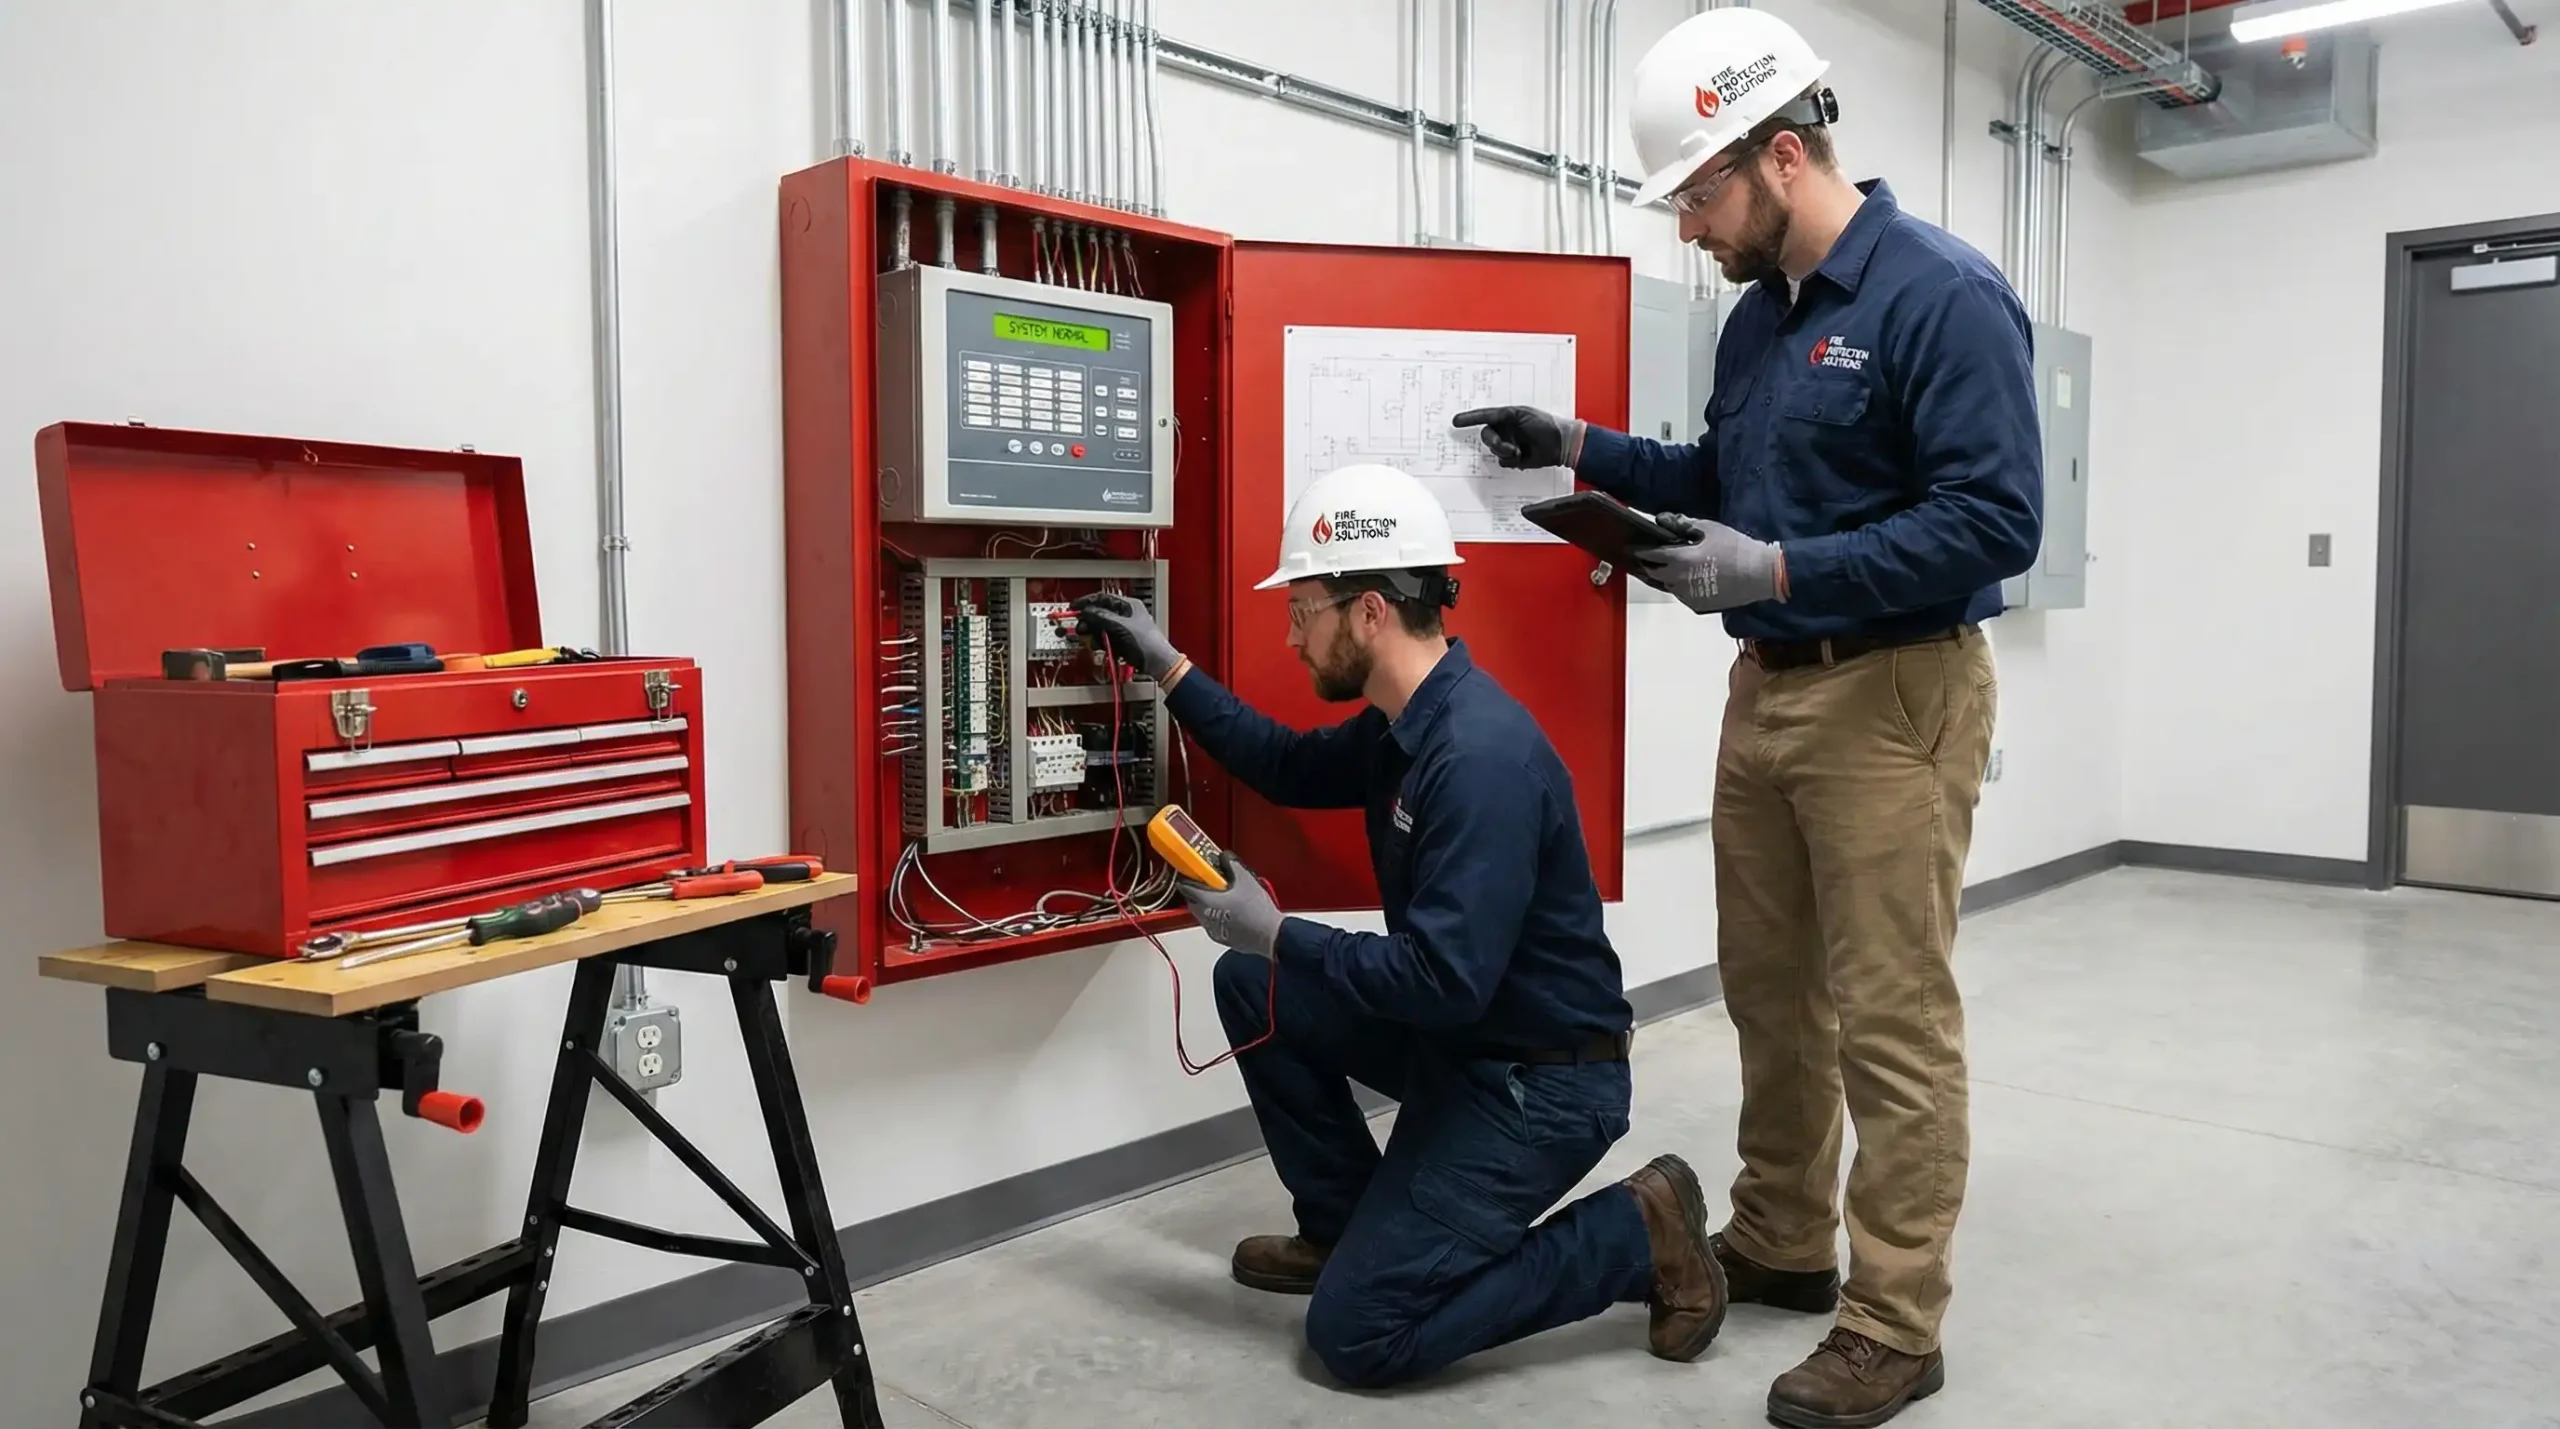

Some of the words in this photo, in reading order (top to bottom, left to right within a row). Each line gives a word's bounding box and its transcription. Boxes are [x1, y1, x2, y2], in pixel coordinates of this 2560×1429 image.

[1723, 65, 1777, 106] SOLUTIONS
[1008, 320, 1048, 338] SYSTEM
[1335, 509, 1356, 520] FIRE
[1335, 527, 1390, 541] SOLUTIONS
